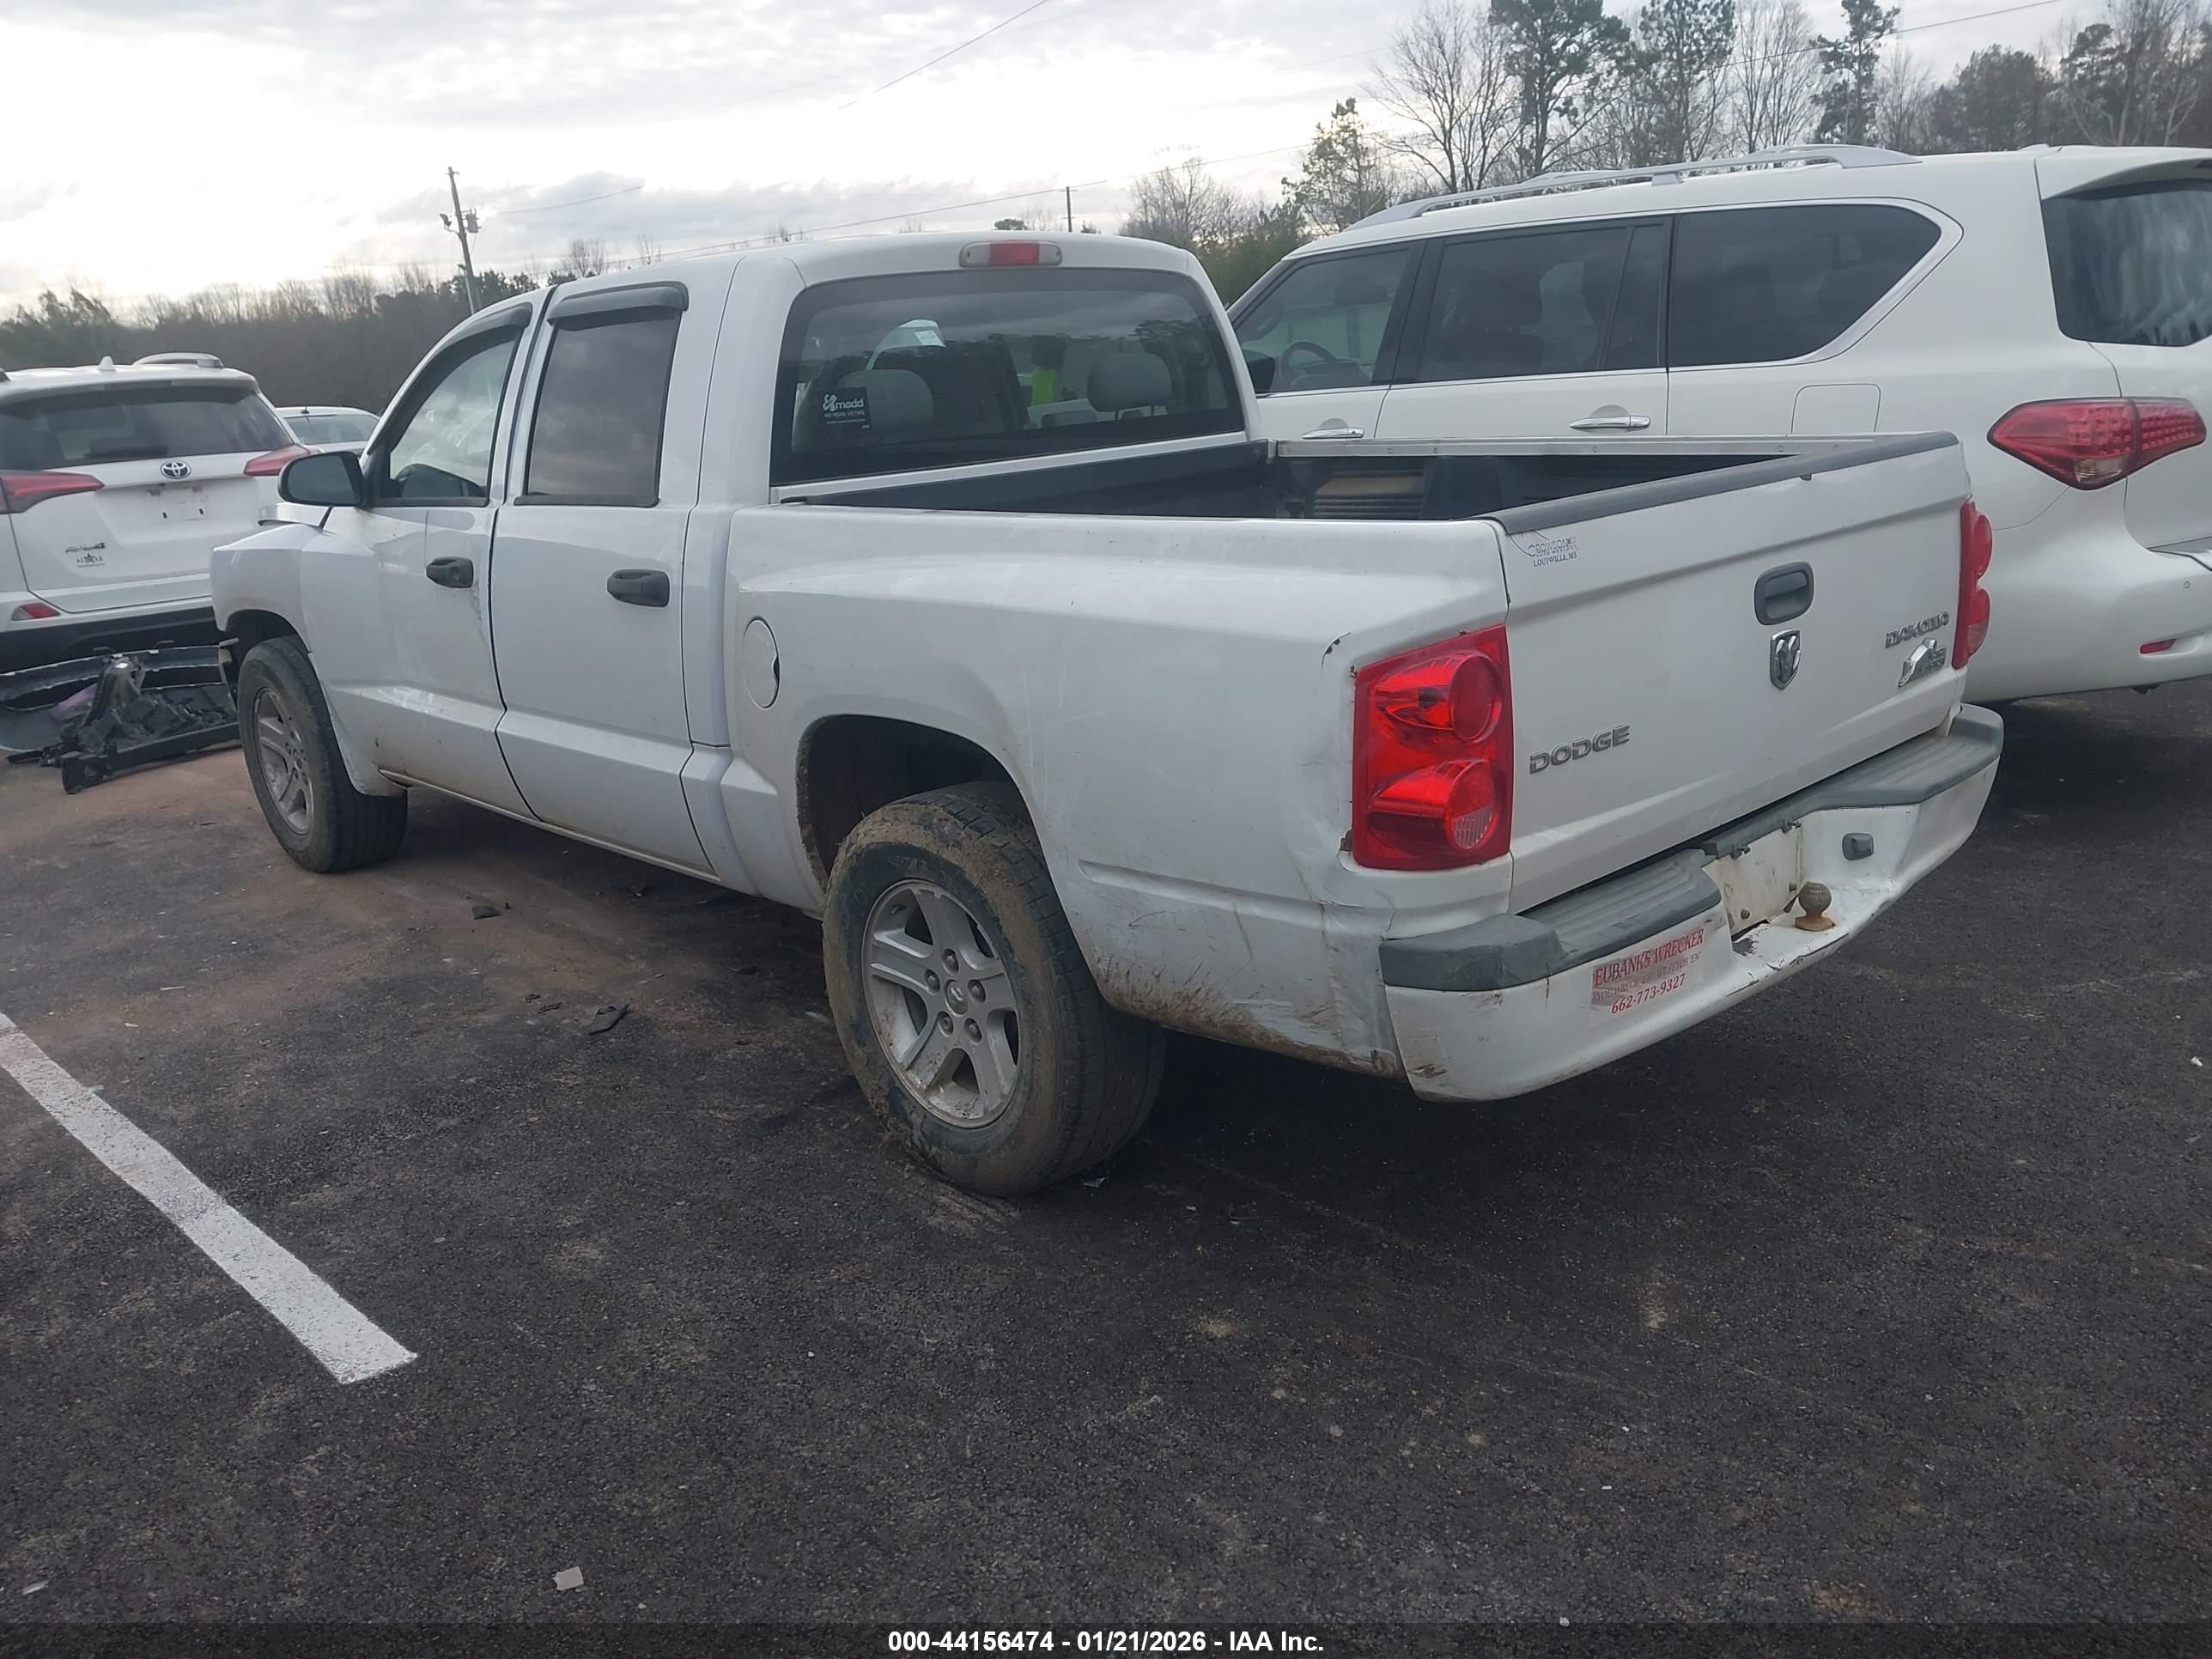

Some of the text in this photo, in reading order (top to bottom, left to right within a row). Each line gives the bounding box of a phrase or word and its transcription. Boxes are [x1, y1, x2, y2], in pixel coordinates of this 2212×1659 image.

[836, 398, 864, 409] madd
[1529, 724, 1630, 775] DODGE
[1595, 928, 1704, 986] EUBANKS WRECKER
[1611, 973, 1686, 1014] 662-773-9327
